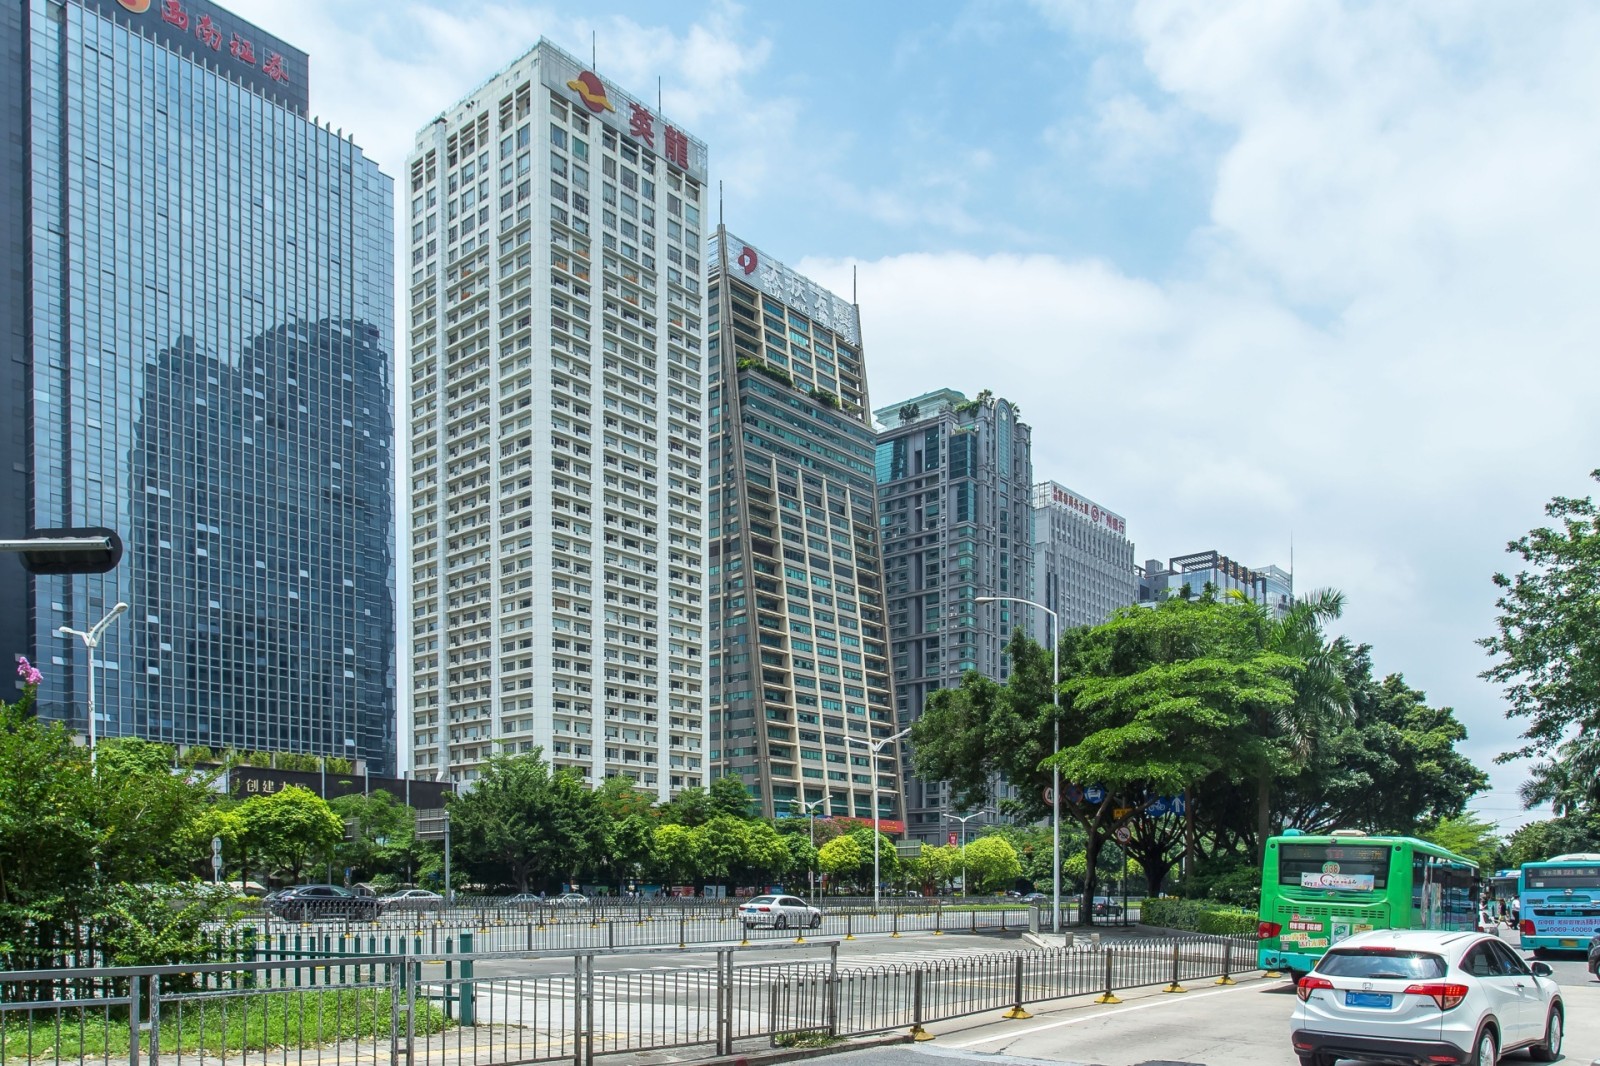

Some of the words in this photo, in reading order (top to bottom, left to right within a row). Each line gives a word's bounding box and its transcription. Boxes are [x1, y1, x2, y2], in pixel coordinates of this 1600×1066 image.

[161, 0, 289, 81] 西南证券
[629, 101, 689, 171] 英龍
[1324, 864, 1338, 874] 338
